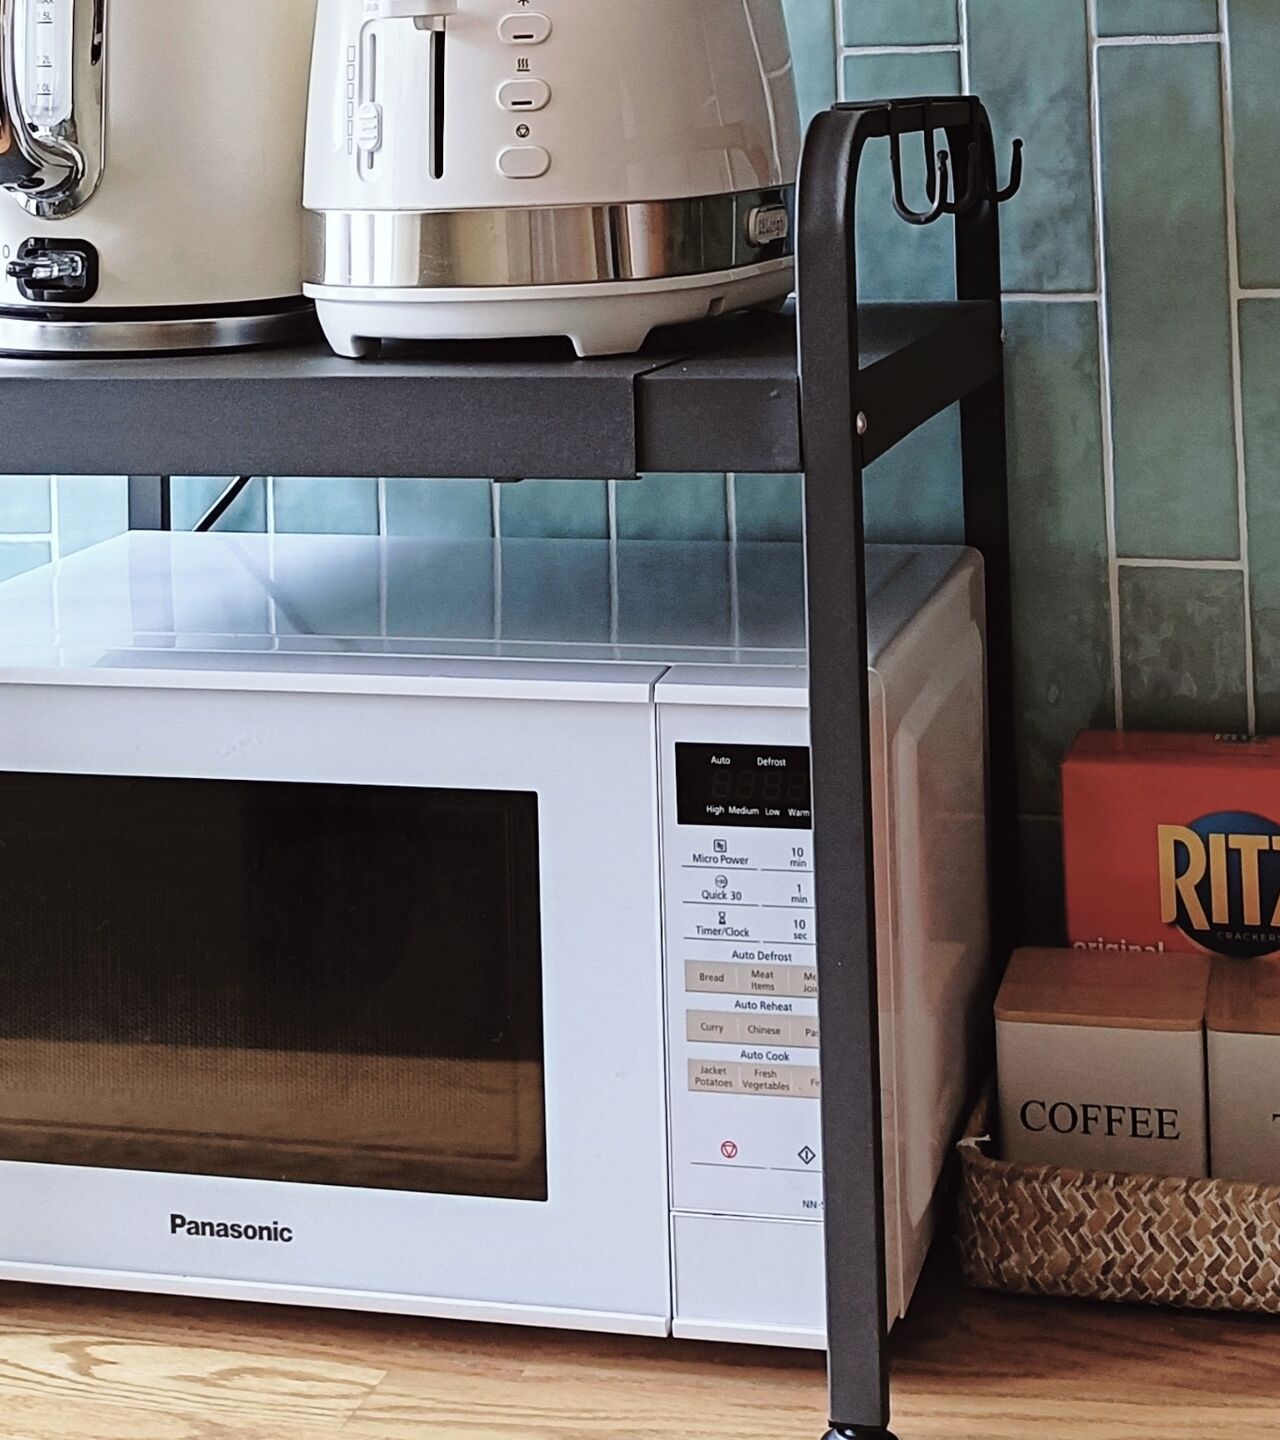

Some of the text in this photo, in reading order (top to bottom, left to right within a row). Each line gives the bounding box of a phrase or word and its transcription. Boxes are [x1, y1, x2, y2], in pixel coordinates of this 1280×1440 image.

[710, 755, 731, 765] Auto
[756, 756, 787, 766] Defrost
[706, 805, 810, 816] High Medium Low Warm
[791, 847, 804, 857] 10
[692, 854, 749, 865] Micro Power
[790, 859, 807, 867] min
[701, 890, 742, 901] Quick 30
[791, 895, 808, 903] min
[793, 919, 806, 929] 10
[696, 925, 750, 937] Timer/Clock
[793, 932, 807, 940] sec
[732, 950, 792, 962] Auto Defrost
[699, 972, 725, 982] Bread
[751, 970, 774, 979] Meat
[751, 982, 775, 991] Items
[734, 1000, 792, 1011] Auto Reheat
[700, 1022, 724, 1034] Curry
[747, 1025, 781, 1035] Chinese
[740, 1050, 790, 1061] Auto Cook
[700, 1066, 726, 1075] Jacket
[754, 1069, 777, 1078] Fresh
[695, 1077, 732, 1087] Potatoes
[742, 1080, 790, 1091] Vegetables
[1020, 1100, 1181, 1140] COFFEE
[170, 1213, 293, 1242] Panasonic
